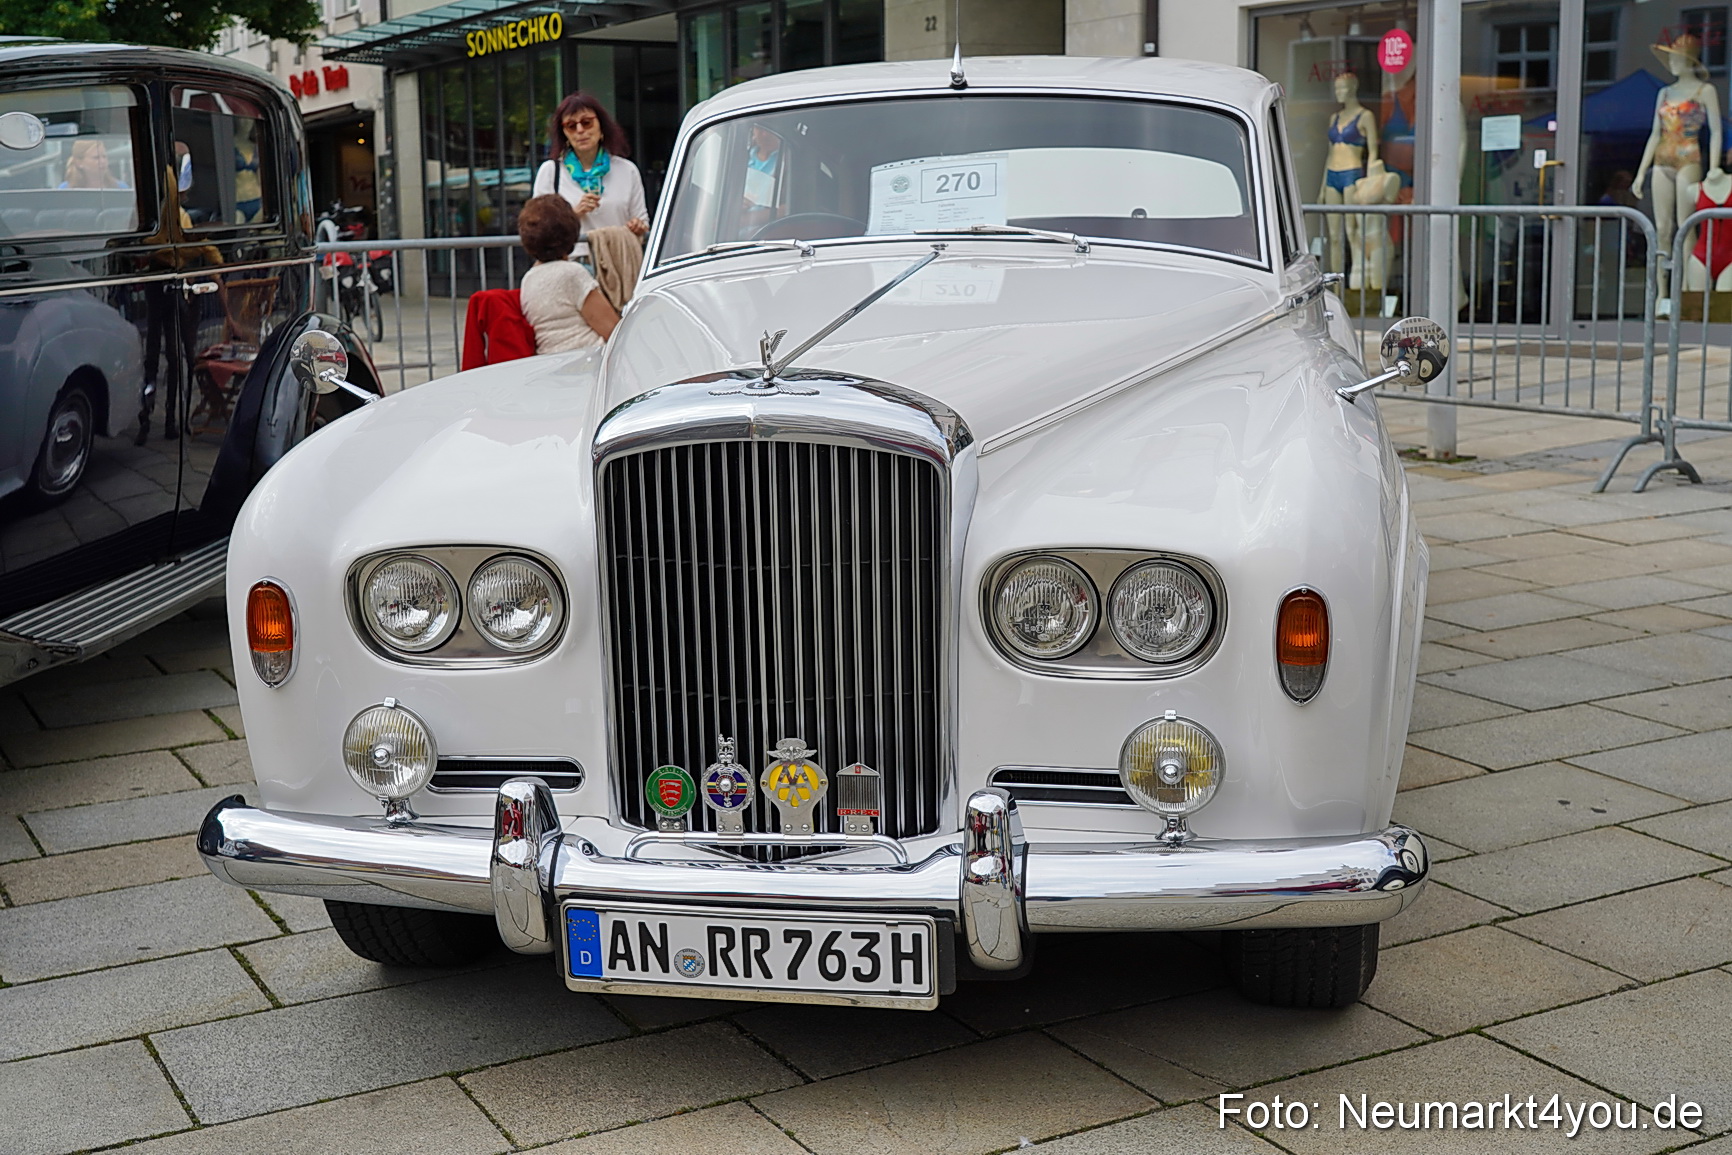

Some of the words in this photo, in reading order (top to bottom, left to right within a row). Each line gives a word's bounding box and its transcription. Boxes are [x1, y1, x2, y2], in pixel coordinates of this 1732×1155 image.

[466, 12, 562, 57] SONNECHKO
[935, 171, 980, 194] 270
[580, 951, 592, 965] D
[608, 920, 670, 974] AN
